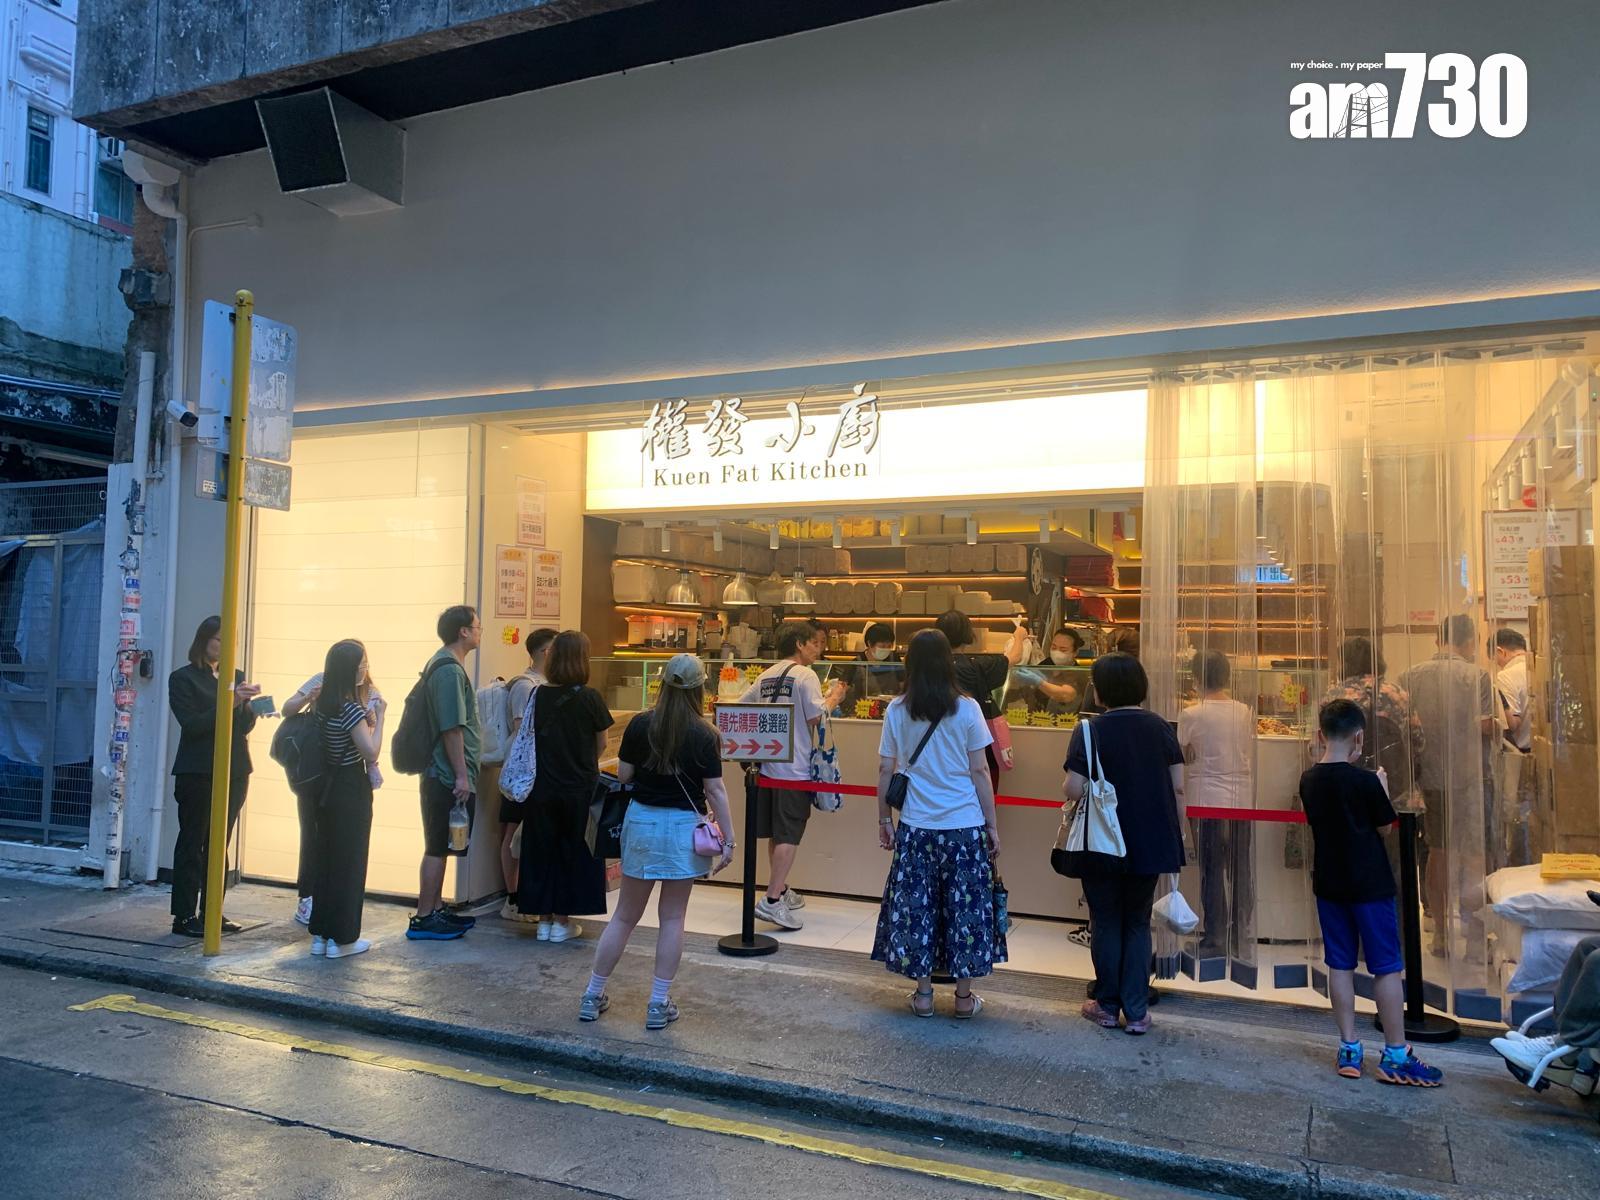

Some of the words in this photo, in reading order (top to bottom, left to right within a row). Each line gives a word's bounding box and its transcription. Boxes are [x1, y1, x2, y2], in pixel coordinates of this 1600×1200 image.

[641, 382, 881, 461] 權發小廚
[654, 468, 710, 487] Kuen
[722, 465, 760, 483] Fat
[771, 459, 868, 481] Kitchen
